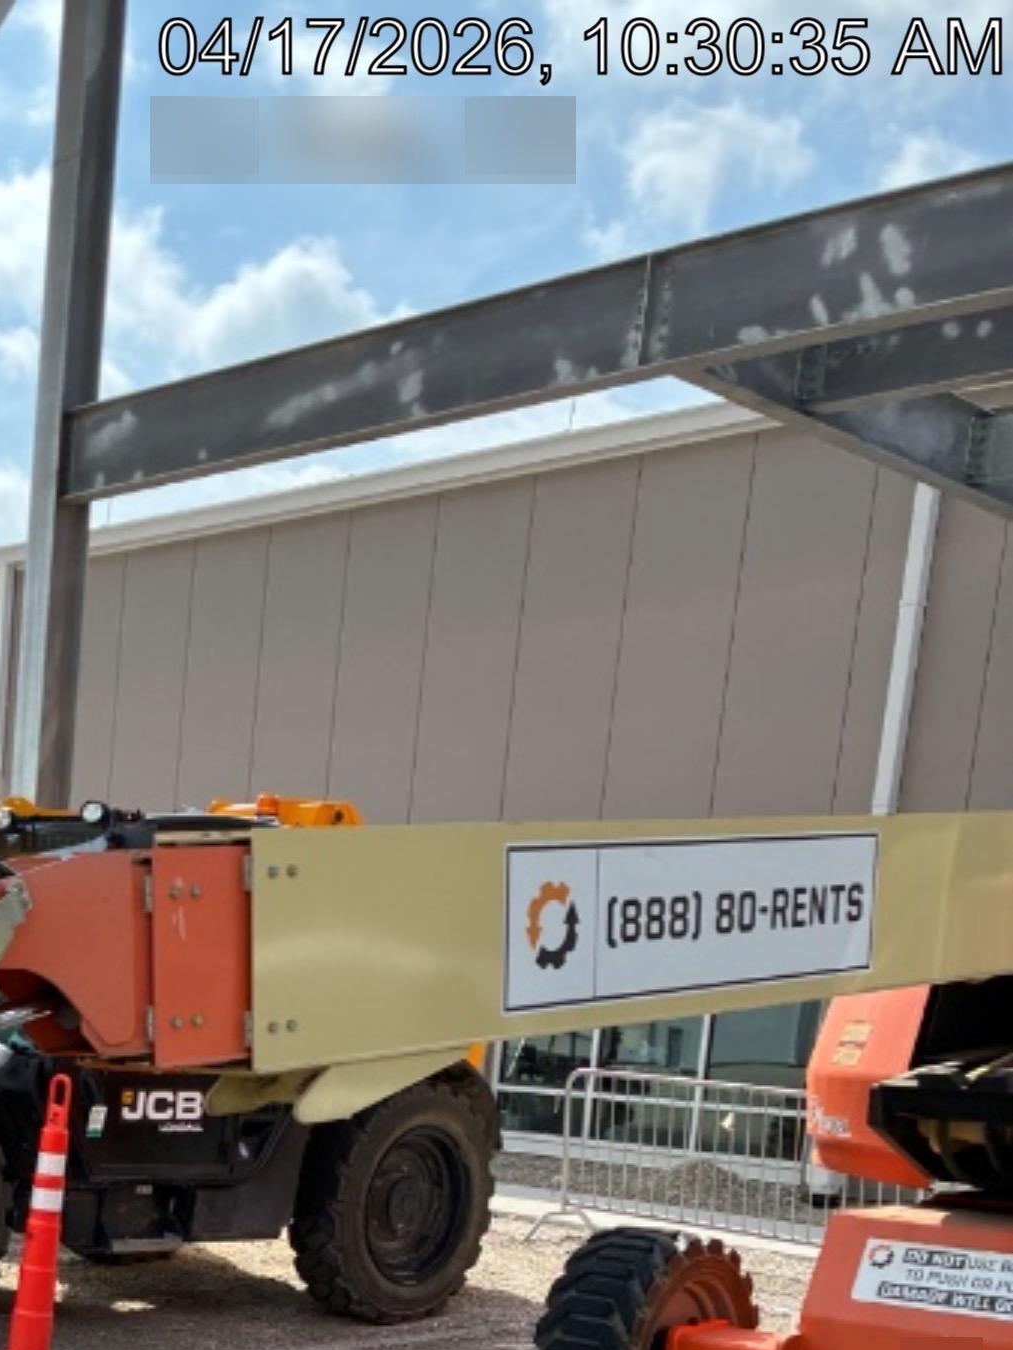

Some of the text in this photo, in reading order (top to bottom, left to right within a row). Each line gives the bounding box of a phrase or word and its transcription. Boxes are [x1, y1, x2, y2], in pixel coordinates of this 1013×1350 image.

[606, 882, 865, 948] (888) 80-RENTS
[121, 1090, 204, 1120] JCB
